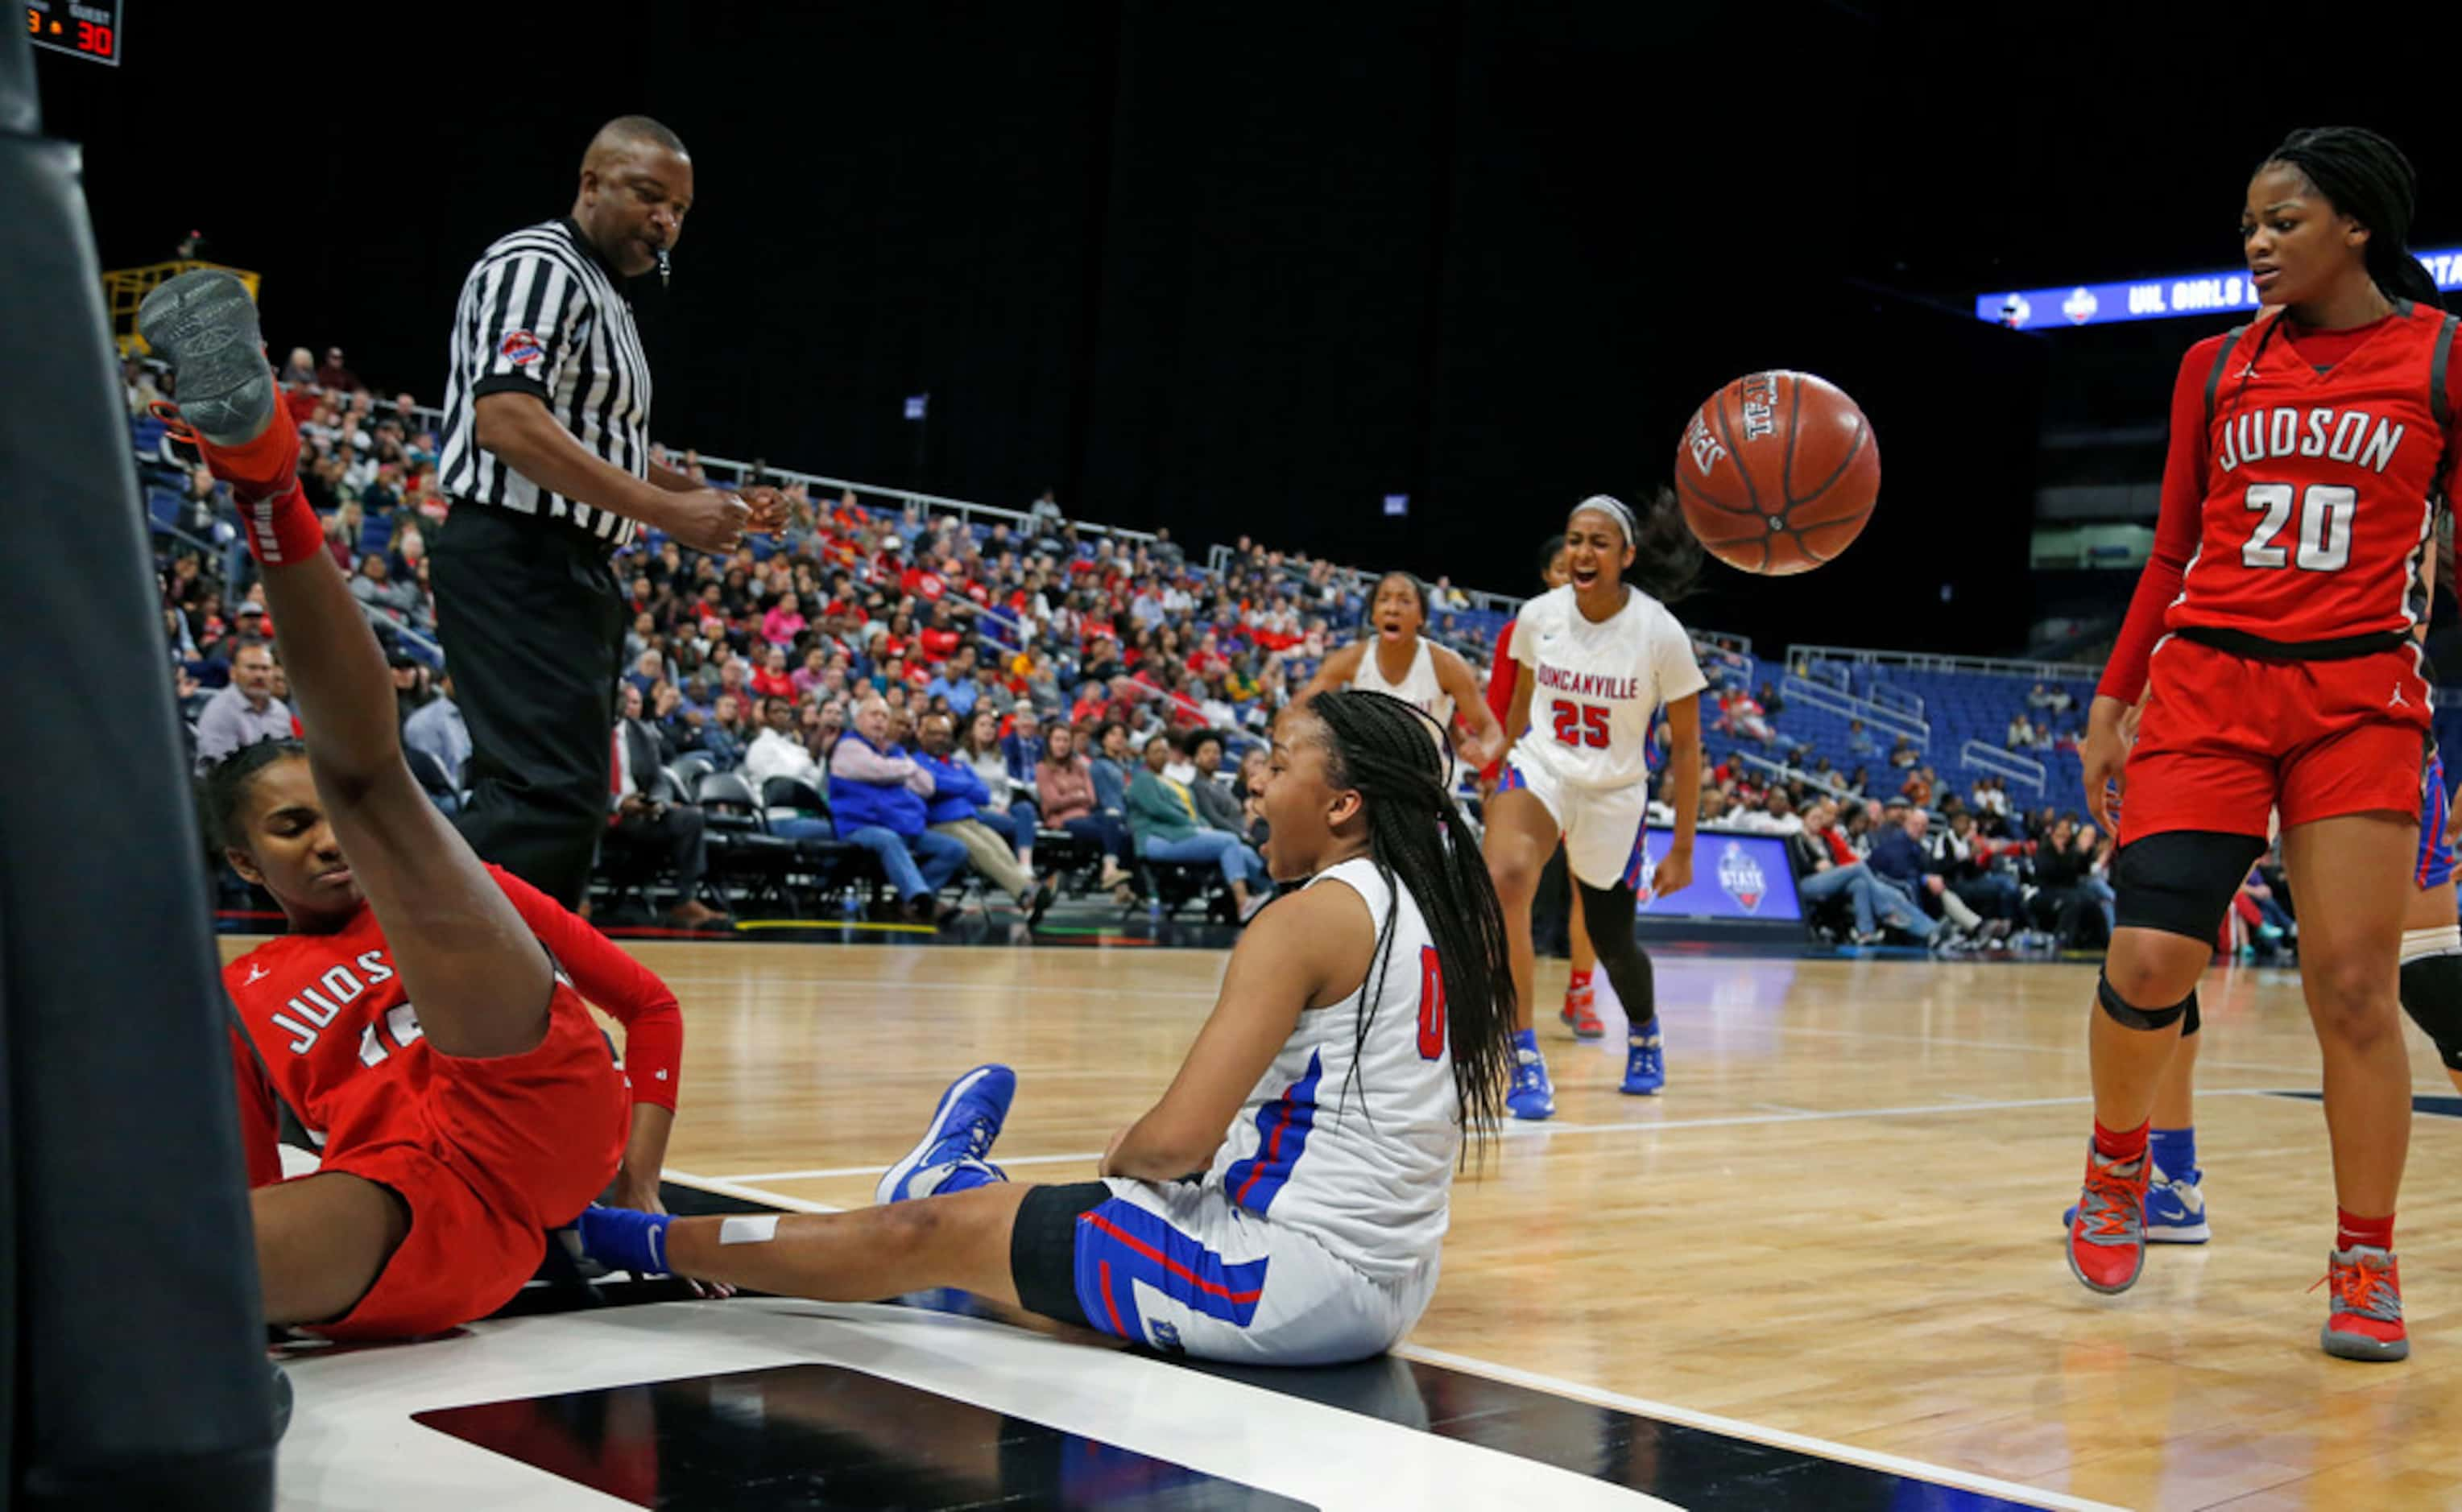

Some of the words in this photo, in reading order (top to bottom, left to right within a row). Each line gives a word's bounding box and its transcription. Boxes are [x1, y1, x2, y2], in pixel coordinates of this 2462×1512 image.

[77, 20, 113, 56] 30
[2129, 285, 2166, 314] UIL
[2171, 276, 2241, 311] GIRLS
[2220, 407, 2404, 473] JUDSON
[2242, 483, 2356, 571] 20
[1551, 699, 1611, 750] 25
[271, 949, 394, 1056] JUDS
[1417, 944, 1447, 1061] 0
